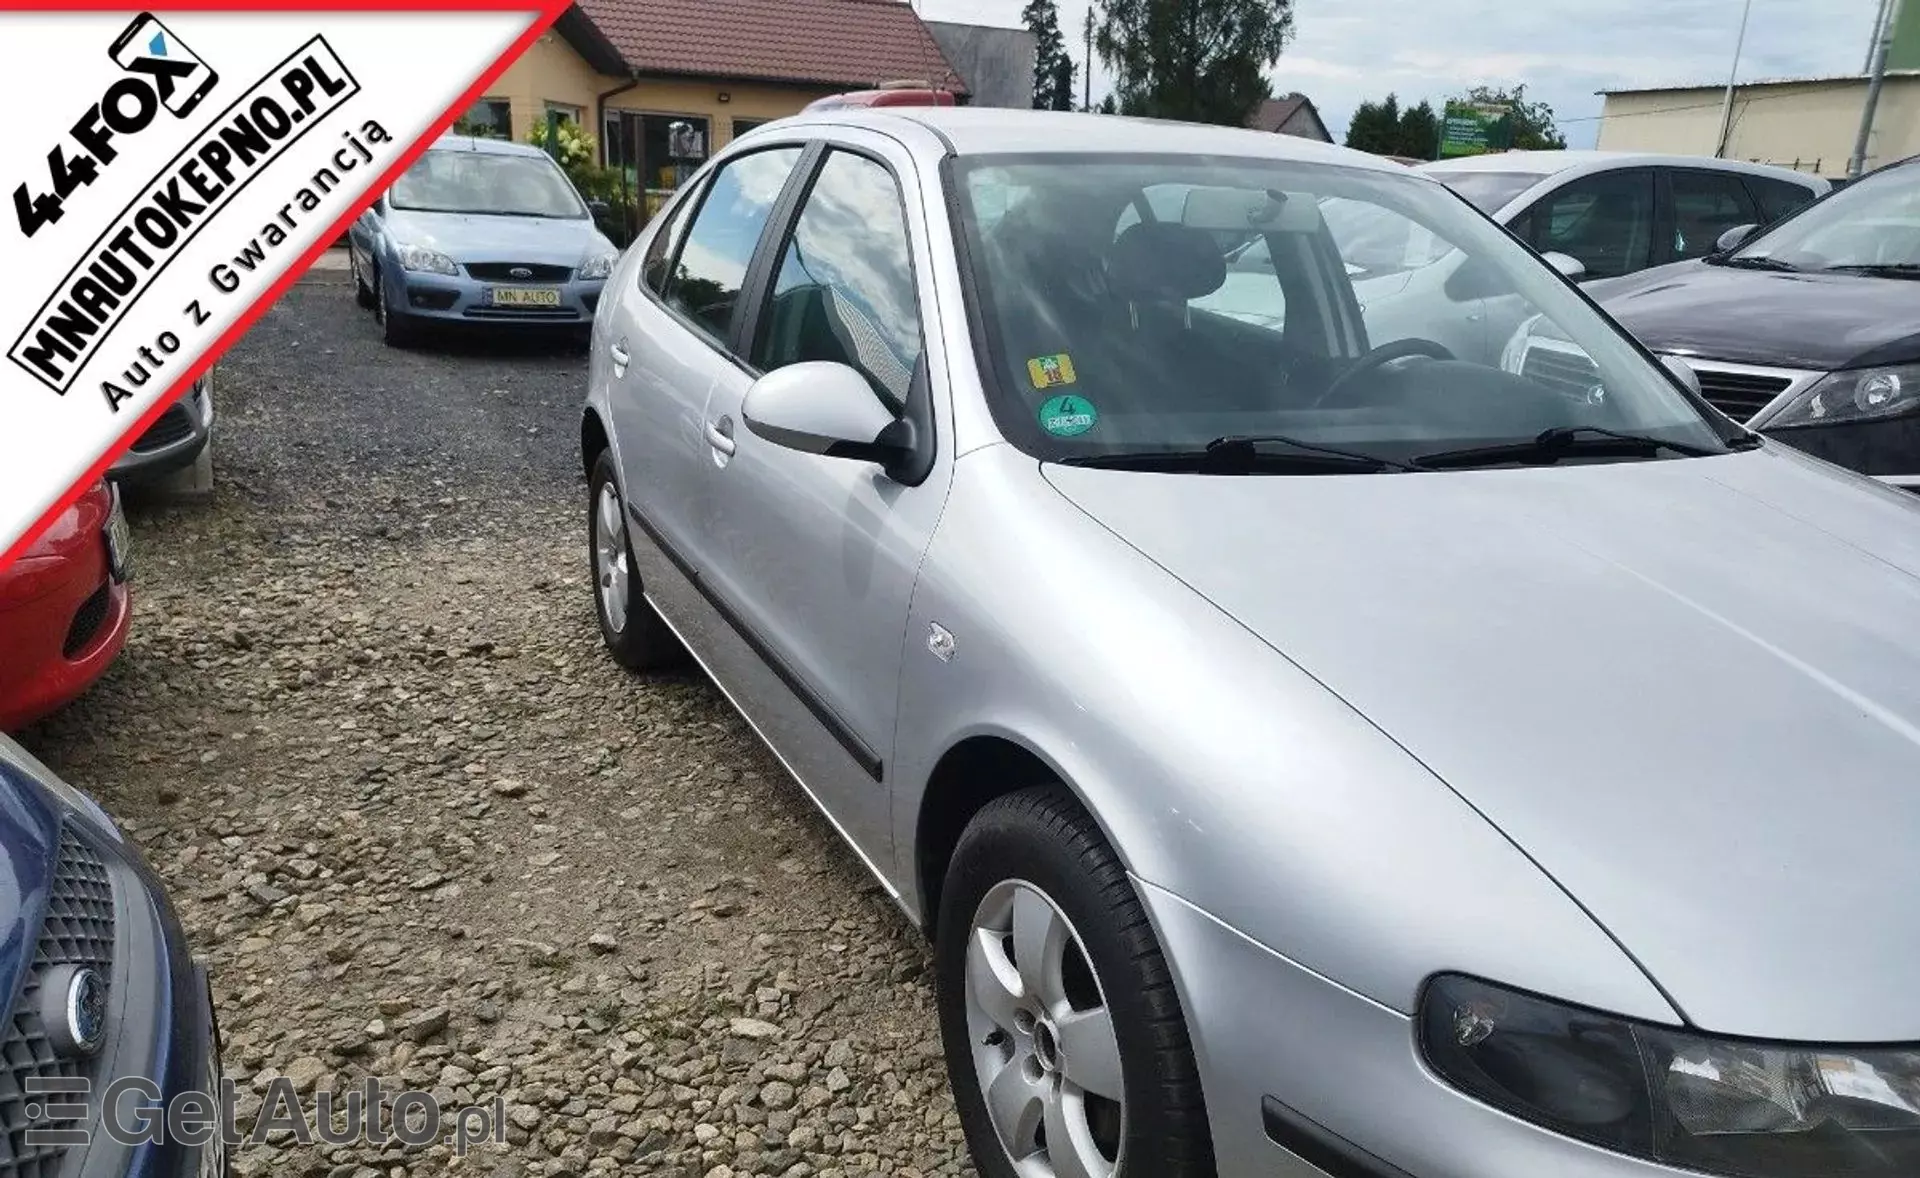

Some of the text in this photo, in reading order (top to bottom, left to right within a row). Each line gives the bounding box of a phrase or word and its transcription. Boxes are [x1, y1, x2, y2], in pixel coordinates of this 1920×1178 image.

[497, 290, 557, 304] MN AUTO
[1060, 396, 1077, 415] 4
